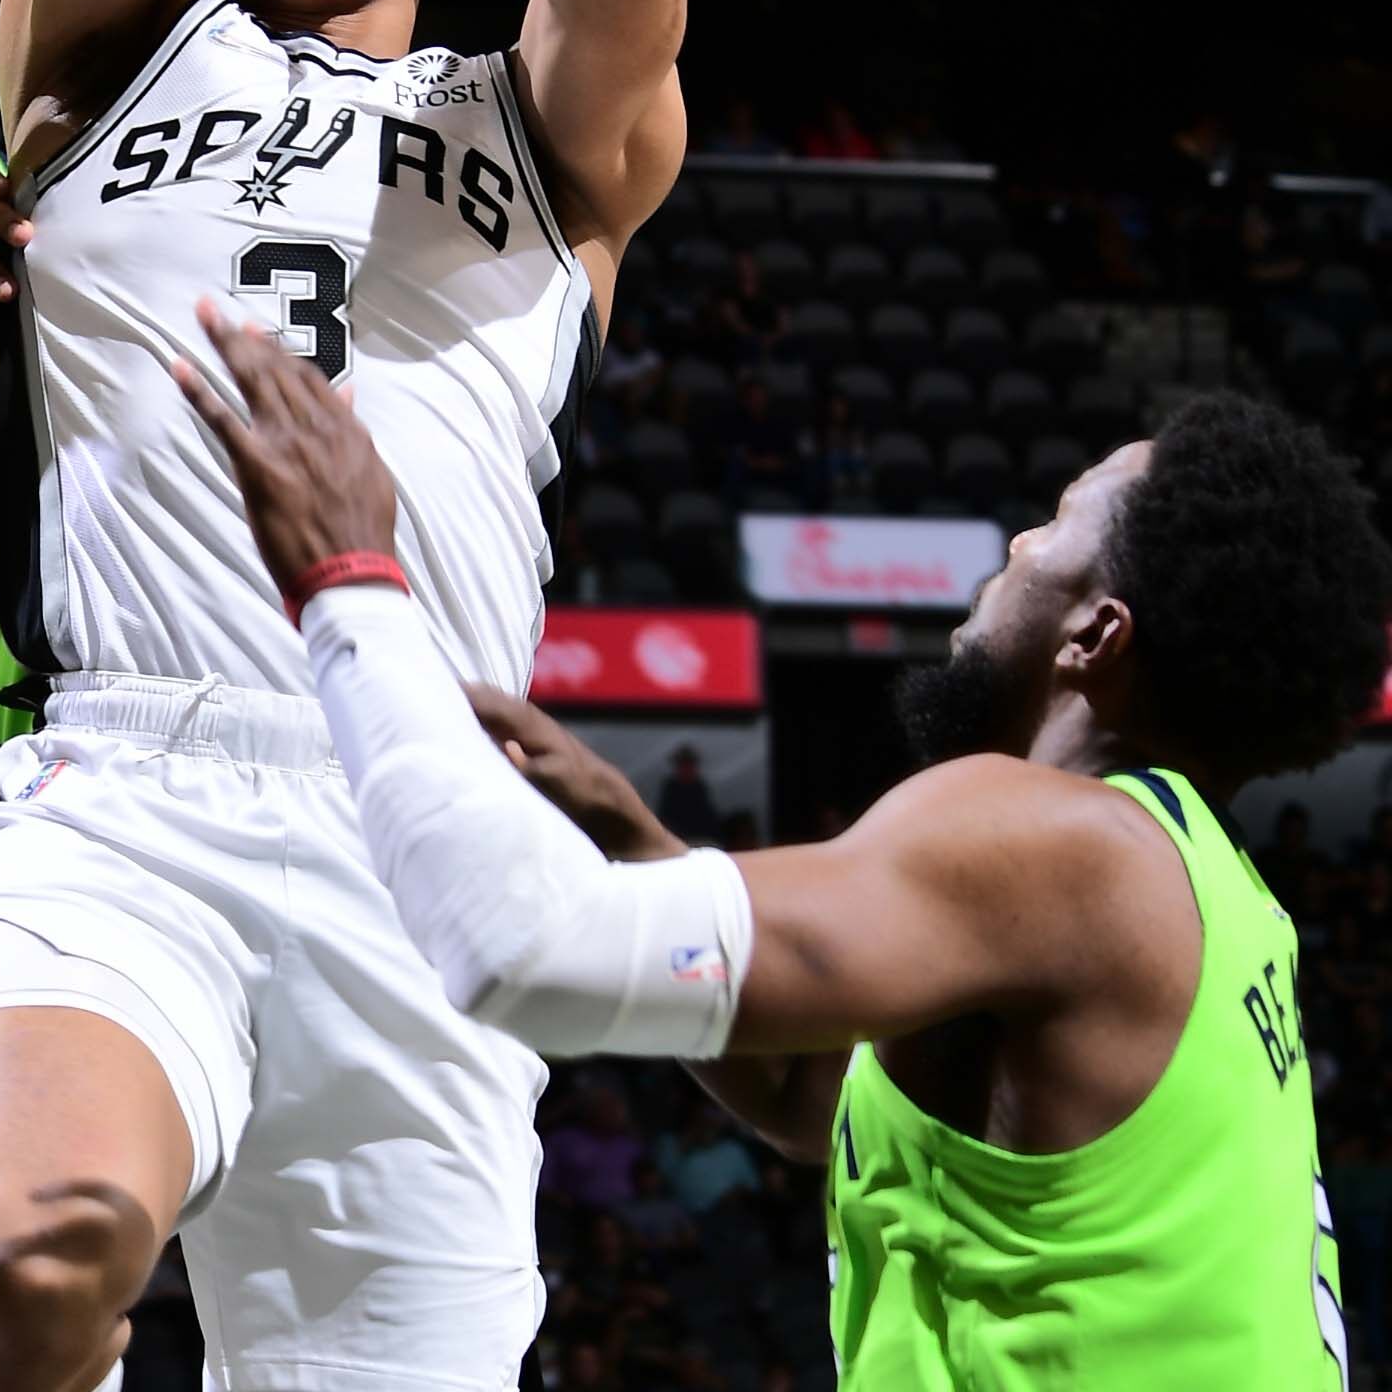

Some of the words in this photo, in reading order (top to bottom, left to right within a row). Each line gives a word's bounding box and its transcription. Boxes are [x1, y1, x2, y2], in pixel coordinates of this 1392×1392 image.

[393, 80, 485, 108] Frost
[100, 96, 514, 254] SPURS
[231, 236, 354, 390] 3
